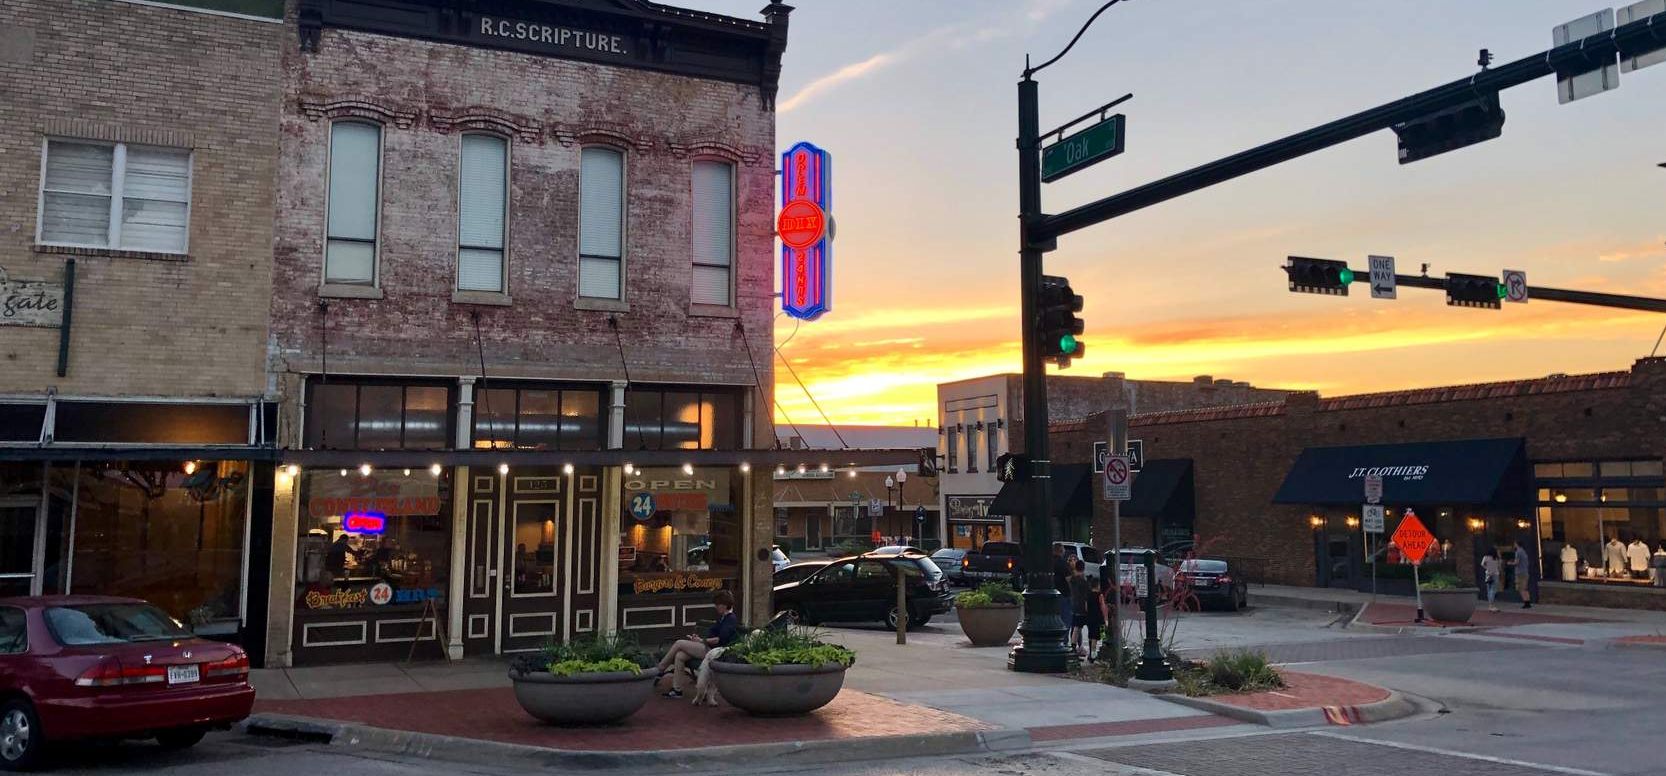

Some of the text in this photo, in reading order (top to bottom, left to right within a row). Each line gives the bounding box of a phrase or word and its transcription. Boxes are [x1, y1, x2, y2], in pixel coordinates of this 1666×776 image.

[1373, 259, 1391, 270] ONE
[1373, 271, 1391, 280] WAY
[1348, 465, 1430, 479] J.T. CLOTHIERS
[624, 480, 716, 490] OPEN
[632, 496, 652, 516] 24
[1400, 530, 1426, 538] DETOUR
[1403, 541, 1426, 550] AHEAD
[374, 587, 389, 601] 24
